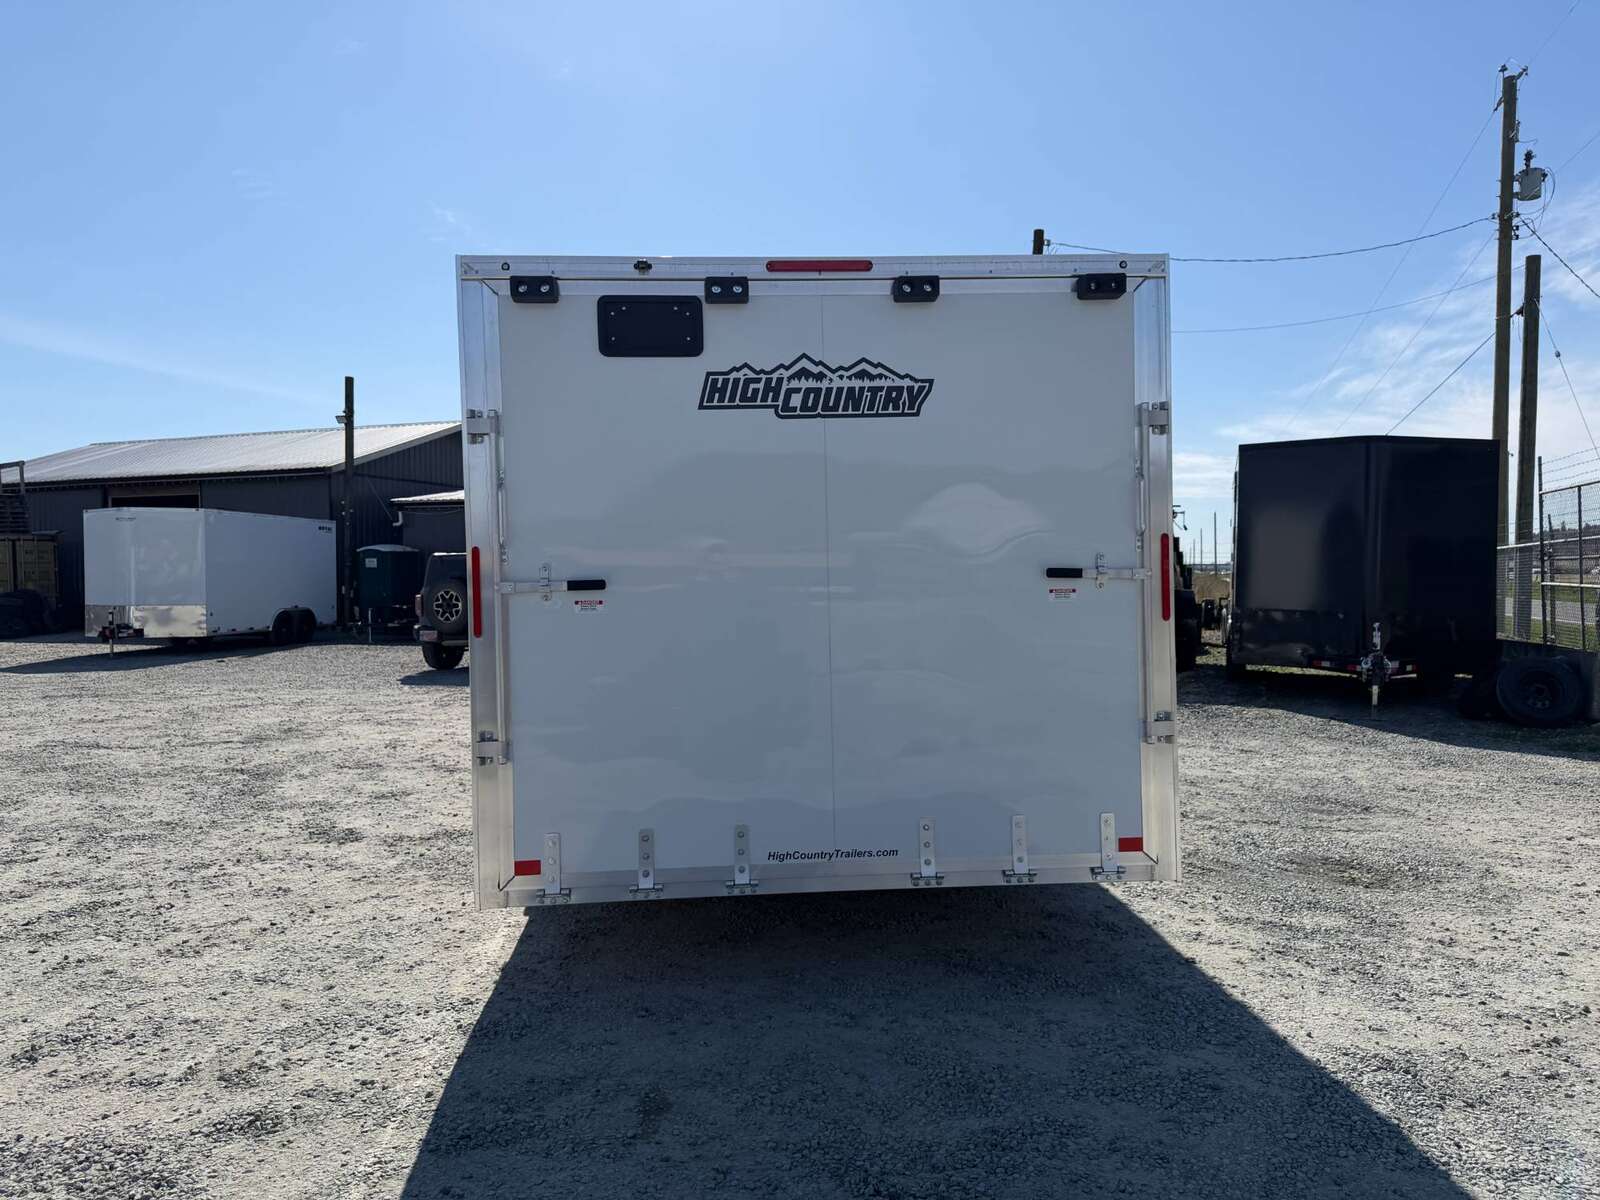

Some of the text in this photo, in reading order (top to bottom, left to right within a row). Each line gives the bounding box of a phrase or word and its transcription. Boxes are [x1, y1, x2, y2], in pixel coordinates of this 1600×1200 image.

[705, 377, 926, 413] HIGH COUNTRY
[767, 849, 898, 862] HighCountryTrailers.com
